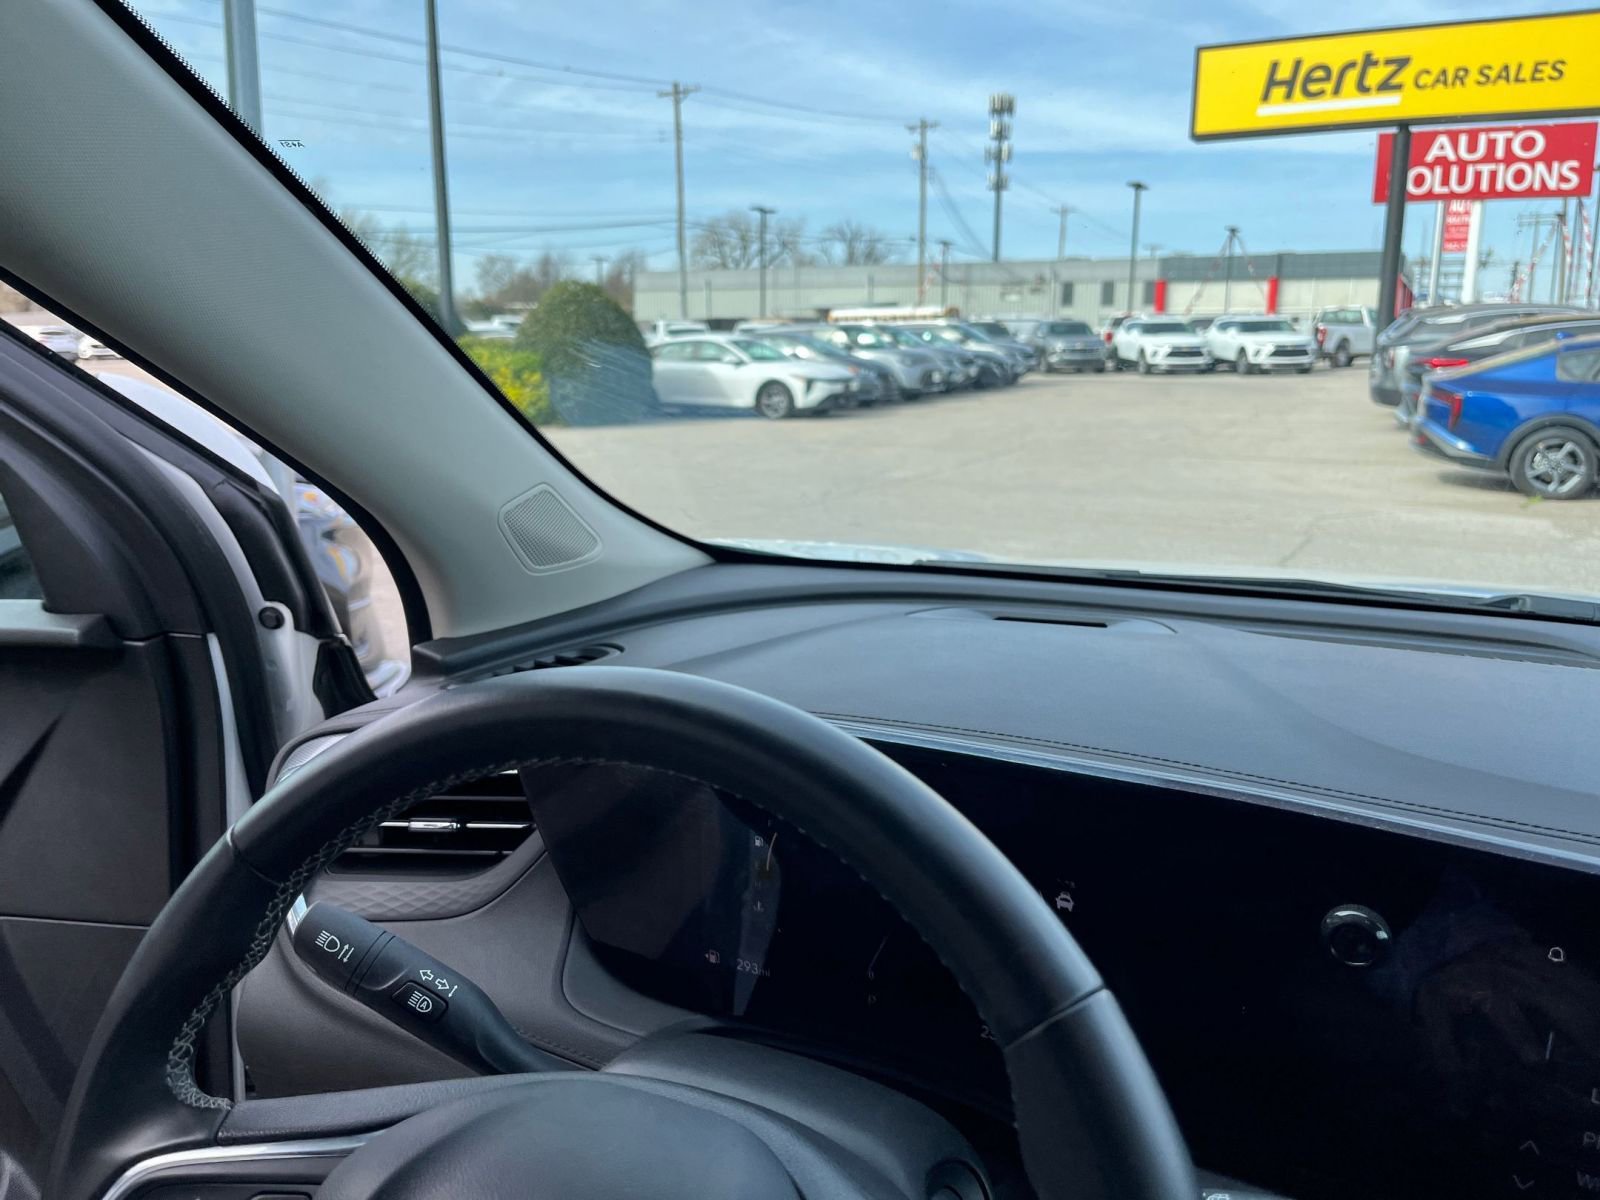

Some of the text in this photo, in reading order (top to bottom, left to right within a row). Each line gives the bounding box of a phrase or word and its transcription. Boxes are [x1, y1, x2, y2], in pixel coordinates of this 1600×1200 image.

[1260, 50, 1567, 103] Hertz CAR SALES
[1424, 129, 1547, 164] AUTO
[1404, 159, 1581, 196] OLUTIONS
